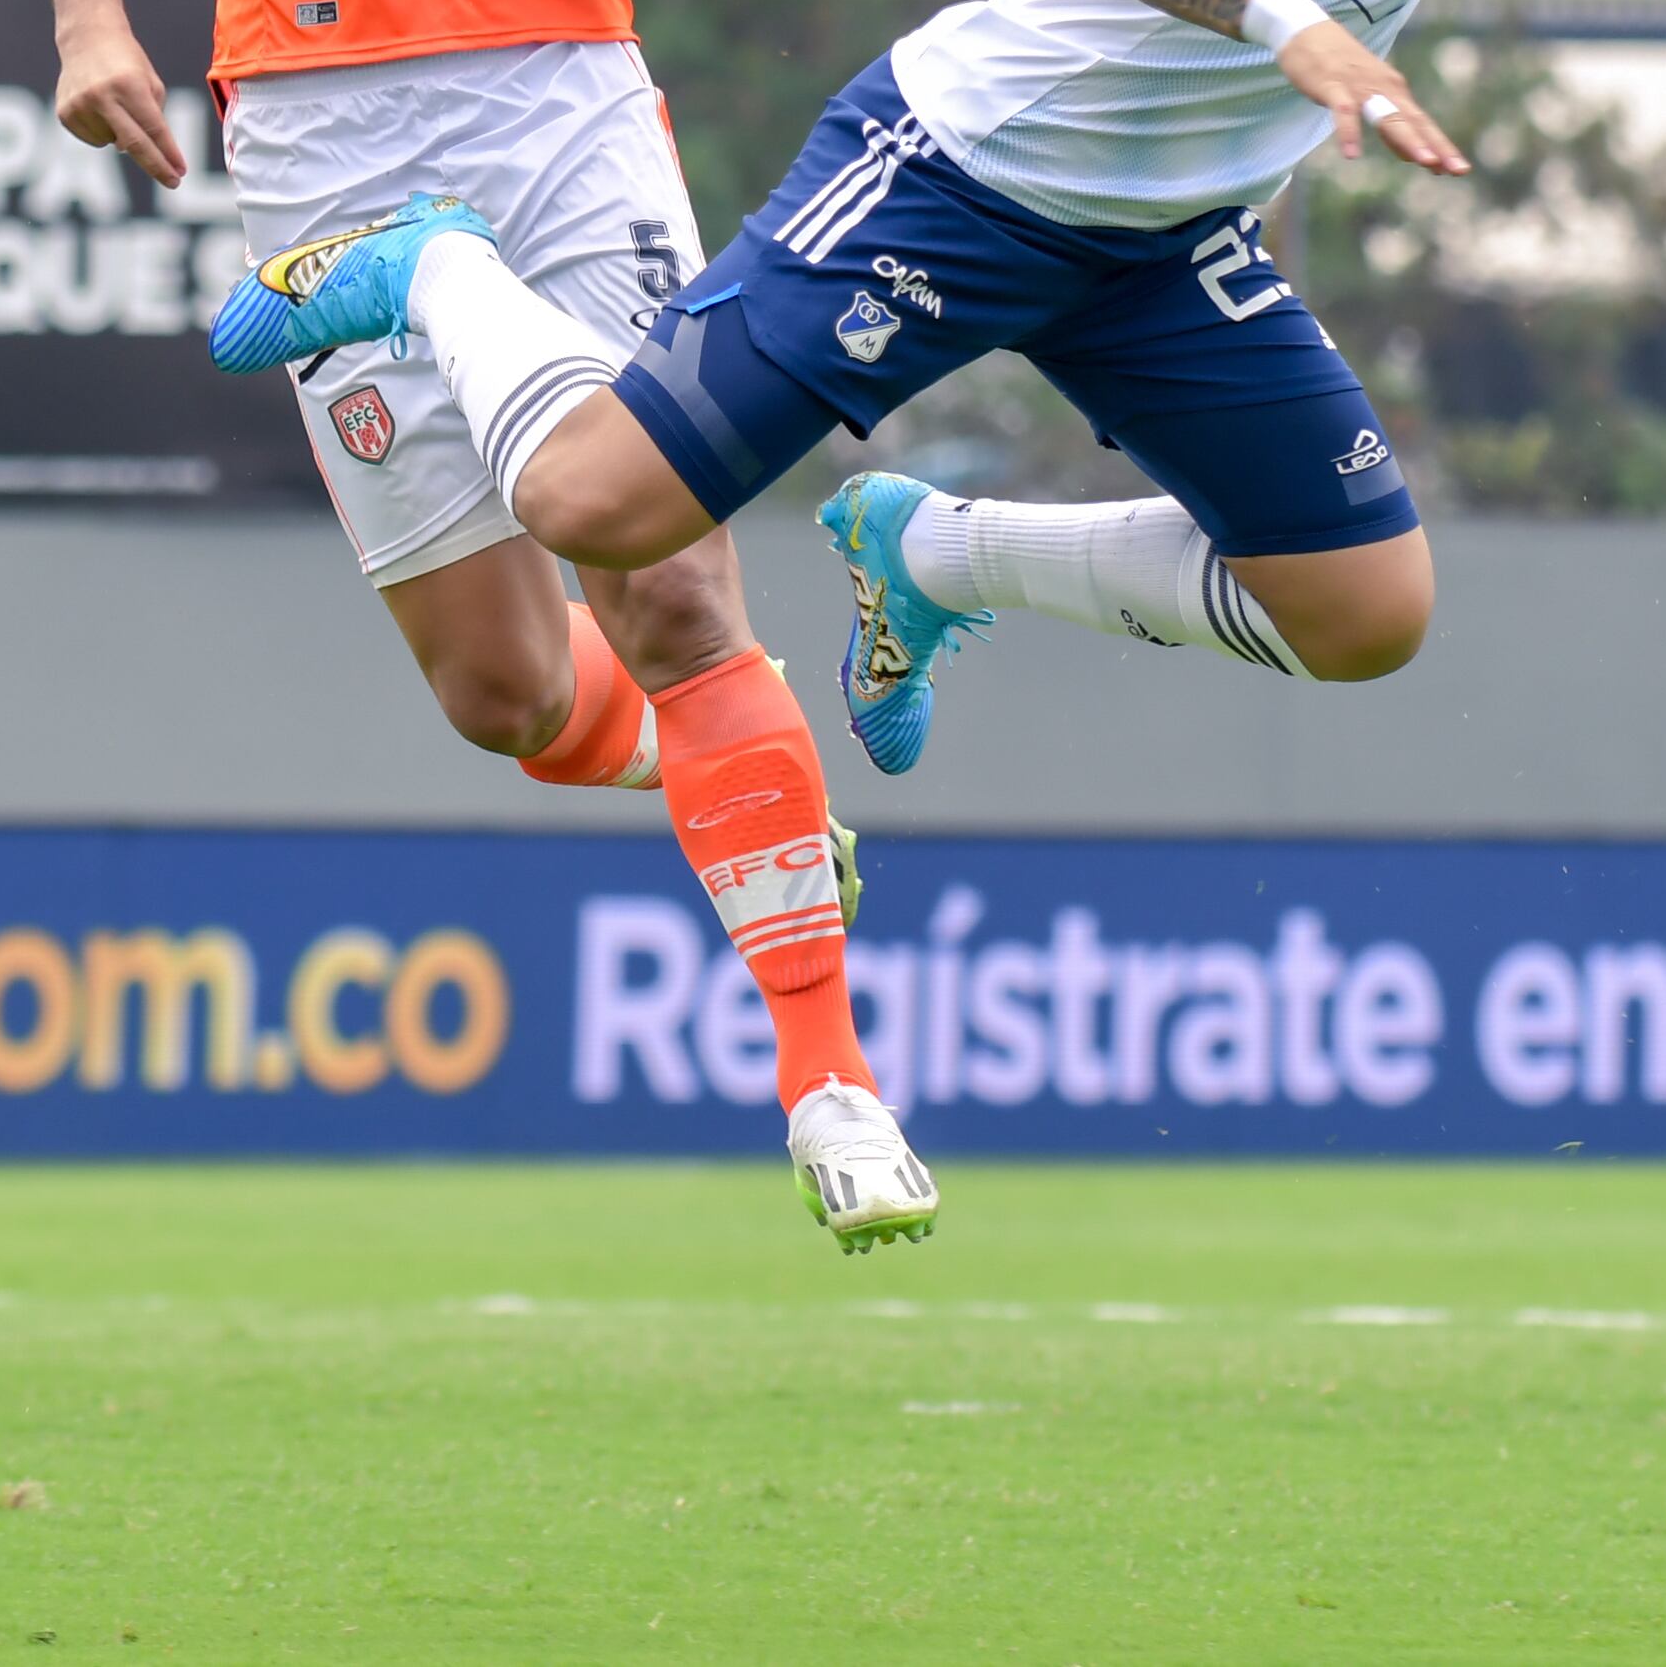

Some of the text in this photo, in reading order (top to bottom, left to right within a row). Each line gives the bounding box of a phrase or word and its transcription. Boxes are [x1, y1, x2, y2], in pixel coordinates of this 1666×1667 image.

[629, 219, 683, 303] 5
[858, 335, 877, 355] M
[343, 406, 377, 432] EFC
[703, 841, 825, 898] EFC
